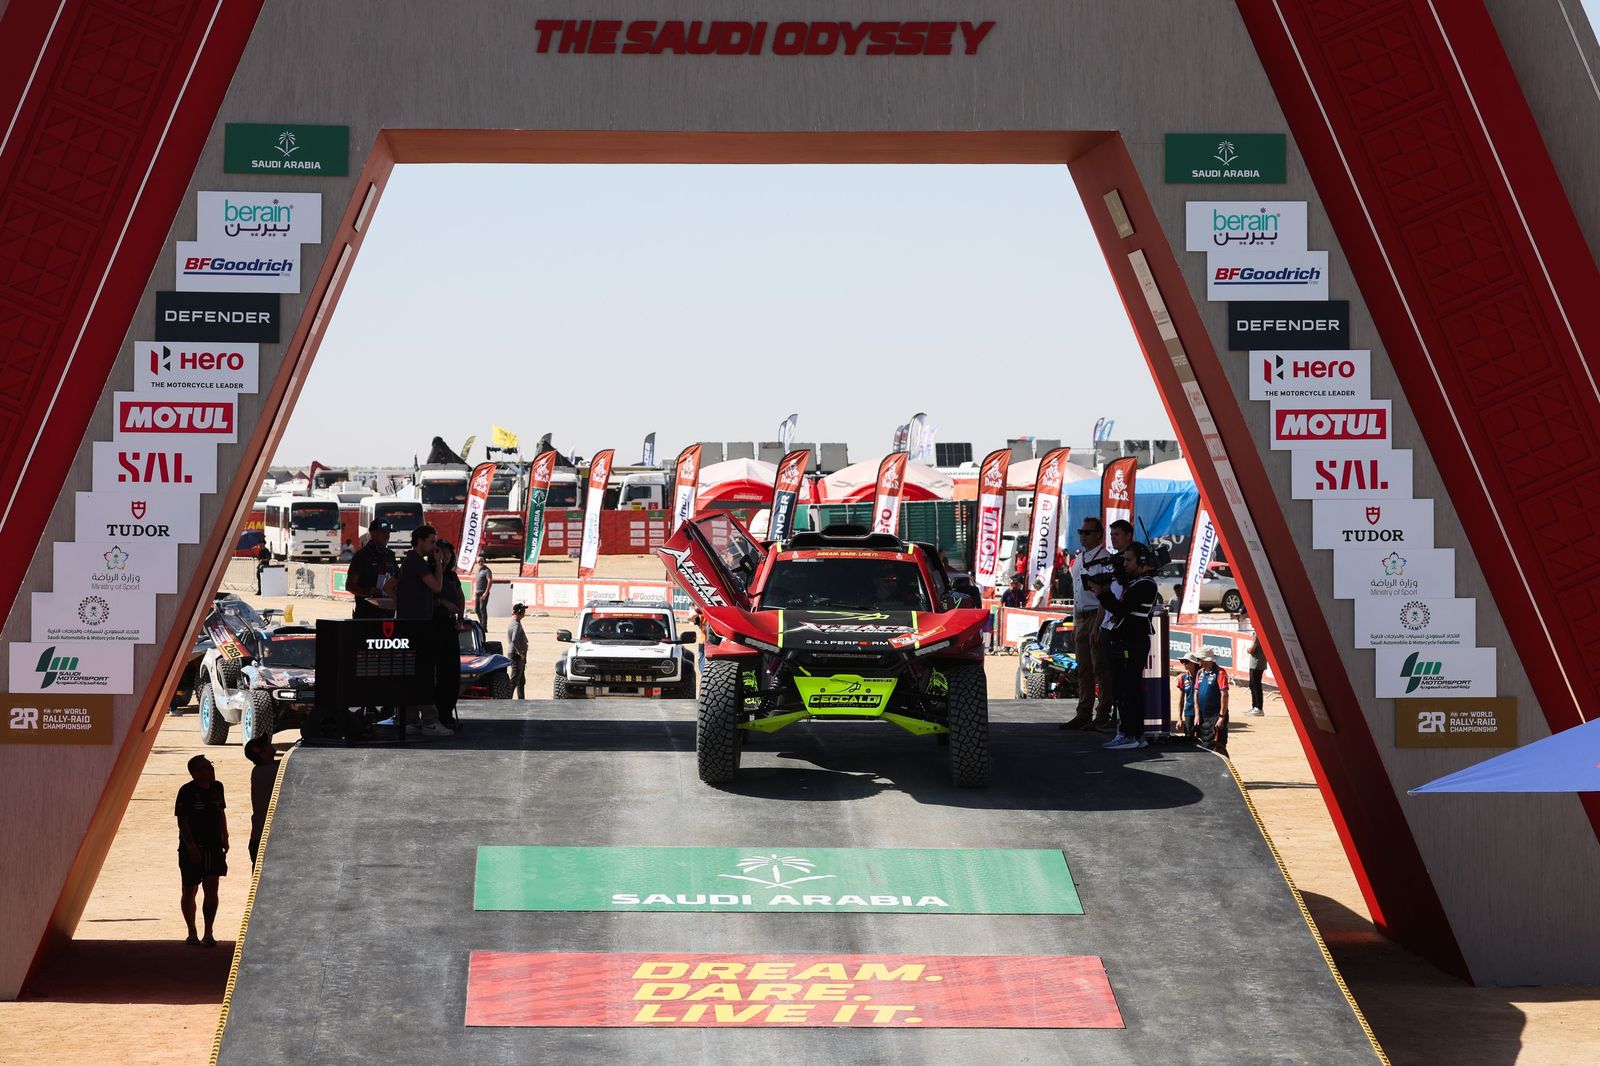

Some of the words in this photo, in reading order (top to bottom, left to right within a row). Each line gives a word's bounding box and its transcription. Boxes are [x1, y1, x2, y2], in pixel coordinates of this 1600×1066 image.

[534, 19, 624, 54] THE
[622, 20, 768, 55] SAUDI
[773, 21, 996, 56] ODYSSEY
[251, 159, 281, 169] SAUDI
[283, 160, 321, 170] ARABIA
[1192, 169, 1221, 178] SAUDI
[1223, 169, 1260, 178] ARABIA
[225, 198, 291, 222] berain
[1213, 207, 1278, 231] berain
[225, 223, 290, 237] بيرين
[1213, 232, 1278, 246] بيرين
[184, 257, 293, 272] BFGoodrich
[1215, 267, 1321, 281] BFGoodrich
[164, 310, 271, 323] DEFENDER
[1236, 319, 1340, 331] DEFENDER
[180, 352, 244, 370] Hero
[1292, 360, 1355, 378] Hero
[167, 381, 214, 389] MOTORCYCLE
[125, 406, 228, 430] MOTUL
[1281, 413, 1382, 436] MOTUL
[1108, 489, 1129, 501] DAKAR
[774, 495, 790, 542] ENDER
[106, 524, 170, 537] TUDOR
[464, 511, 479, 554] TUDOR
[1342, 530, 1404, 542] TUDOR
[980, 511, 998, 571] MOTUL
[1037, 515, 1051, 570] TUDOR
[91, 583, 115, 591] Ministry
[122, 583, 140, 591] Sport
[1370, 588, 1393, 596] Ministry
[365, 638, 410, 649] TUDOR
[1169, 640, 1191, 653] FENDER
[224, 643, 241, 659] 269
[810, 695, 881, 704] CECCALDI
[43, 715, 90, 723] RALLY-RAID
[1450, 718, 1496, 726] RALLY-RAID
[612, 893, 752, 905] SAUDI
[768, 895, 950, 907] ARABIA
[631, 961, 944, 982] DREAM.
[631, 983, 873, 1001] DARE.
[632, 1004, 815, 1023] LIVE
[832, 1005, 924, 1023] IT.
